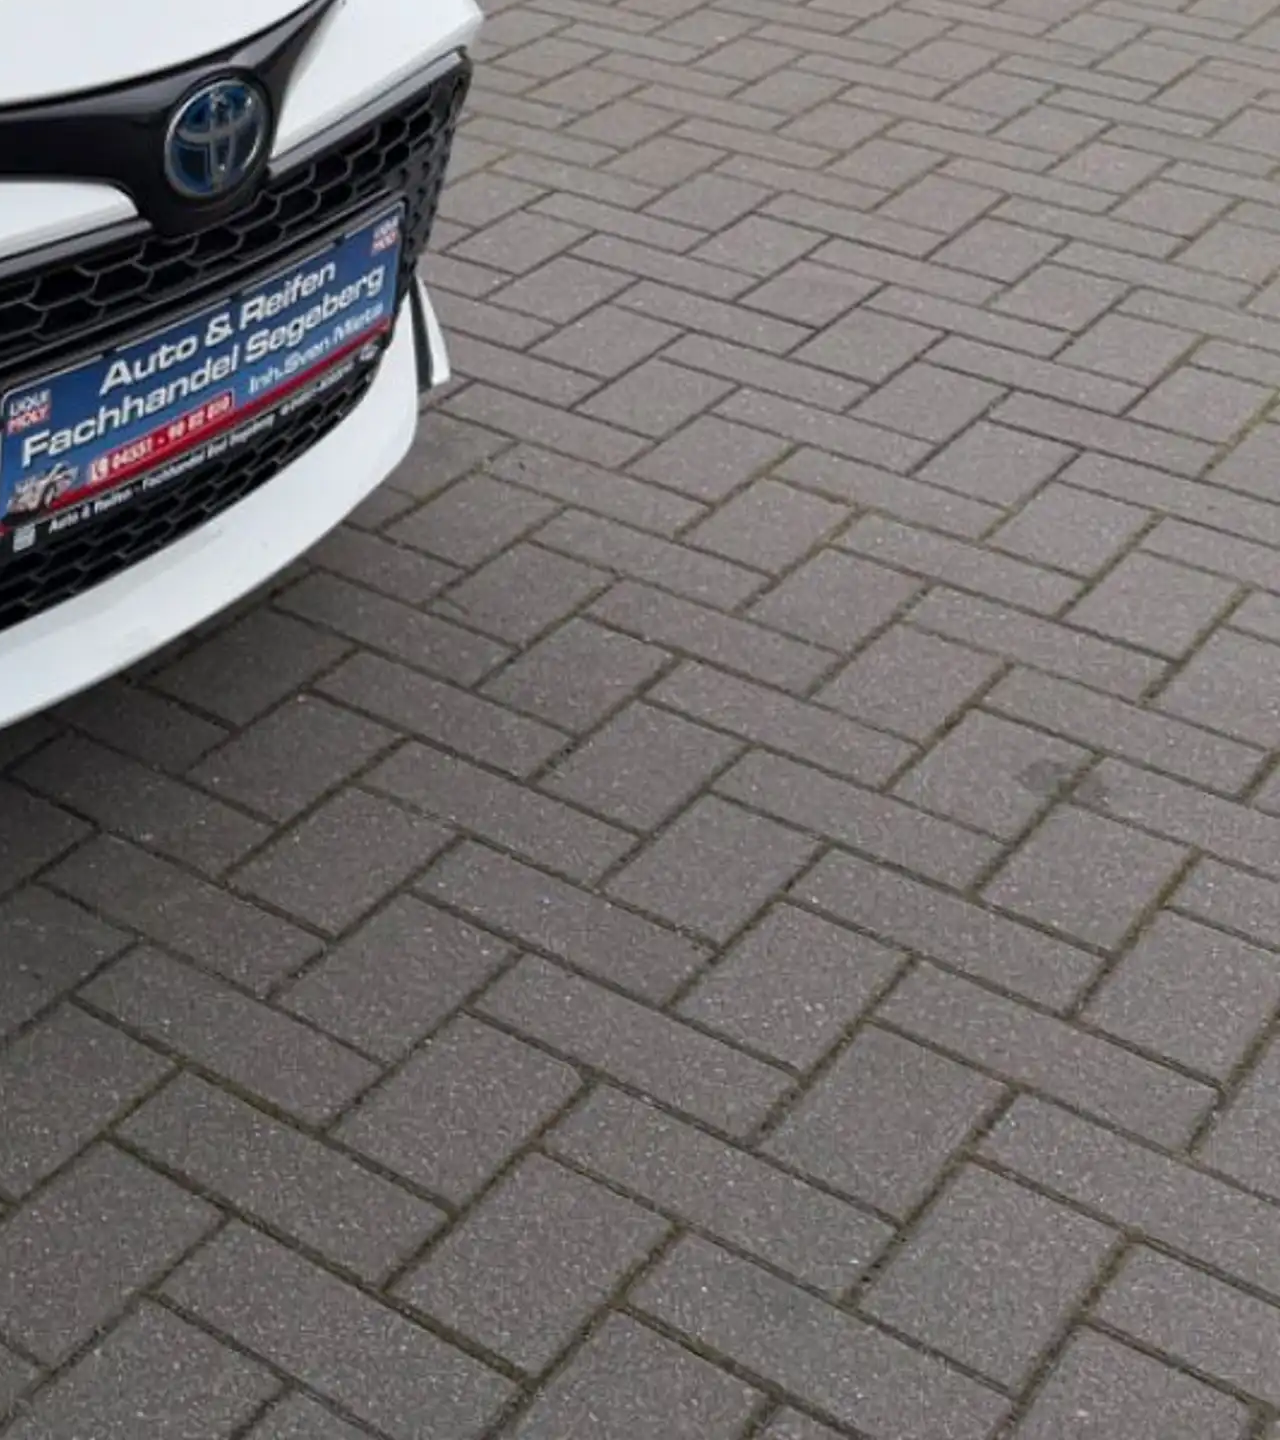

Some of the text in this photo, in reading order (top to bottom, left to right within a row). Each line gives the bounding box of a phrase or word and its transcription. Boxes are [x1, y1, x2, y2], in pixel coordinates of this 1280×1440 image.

[21, 345, 238, 468] Fachhandel
[245, 265, 385, 363] Segeberg
[99, 339, 198, 397] Auto
[205, 311, 234, 347] &
[240, 261, 336, 331] Reifen
